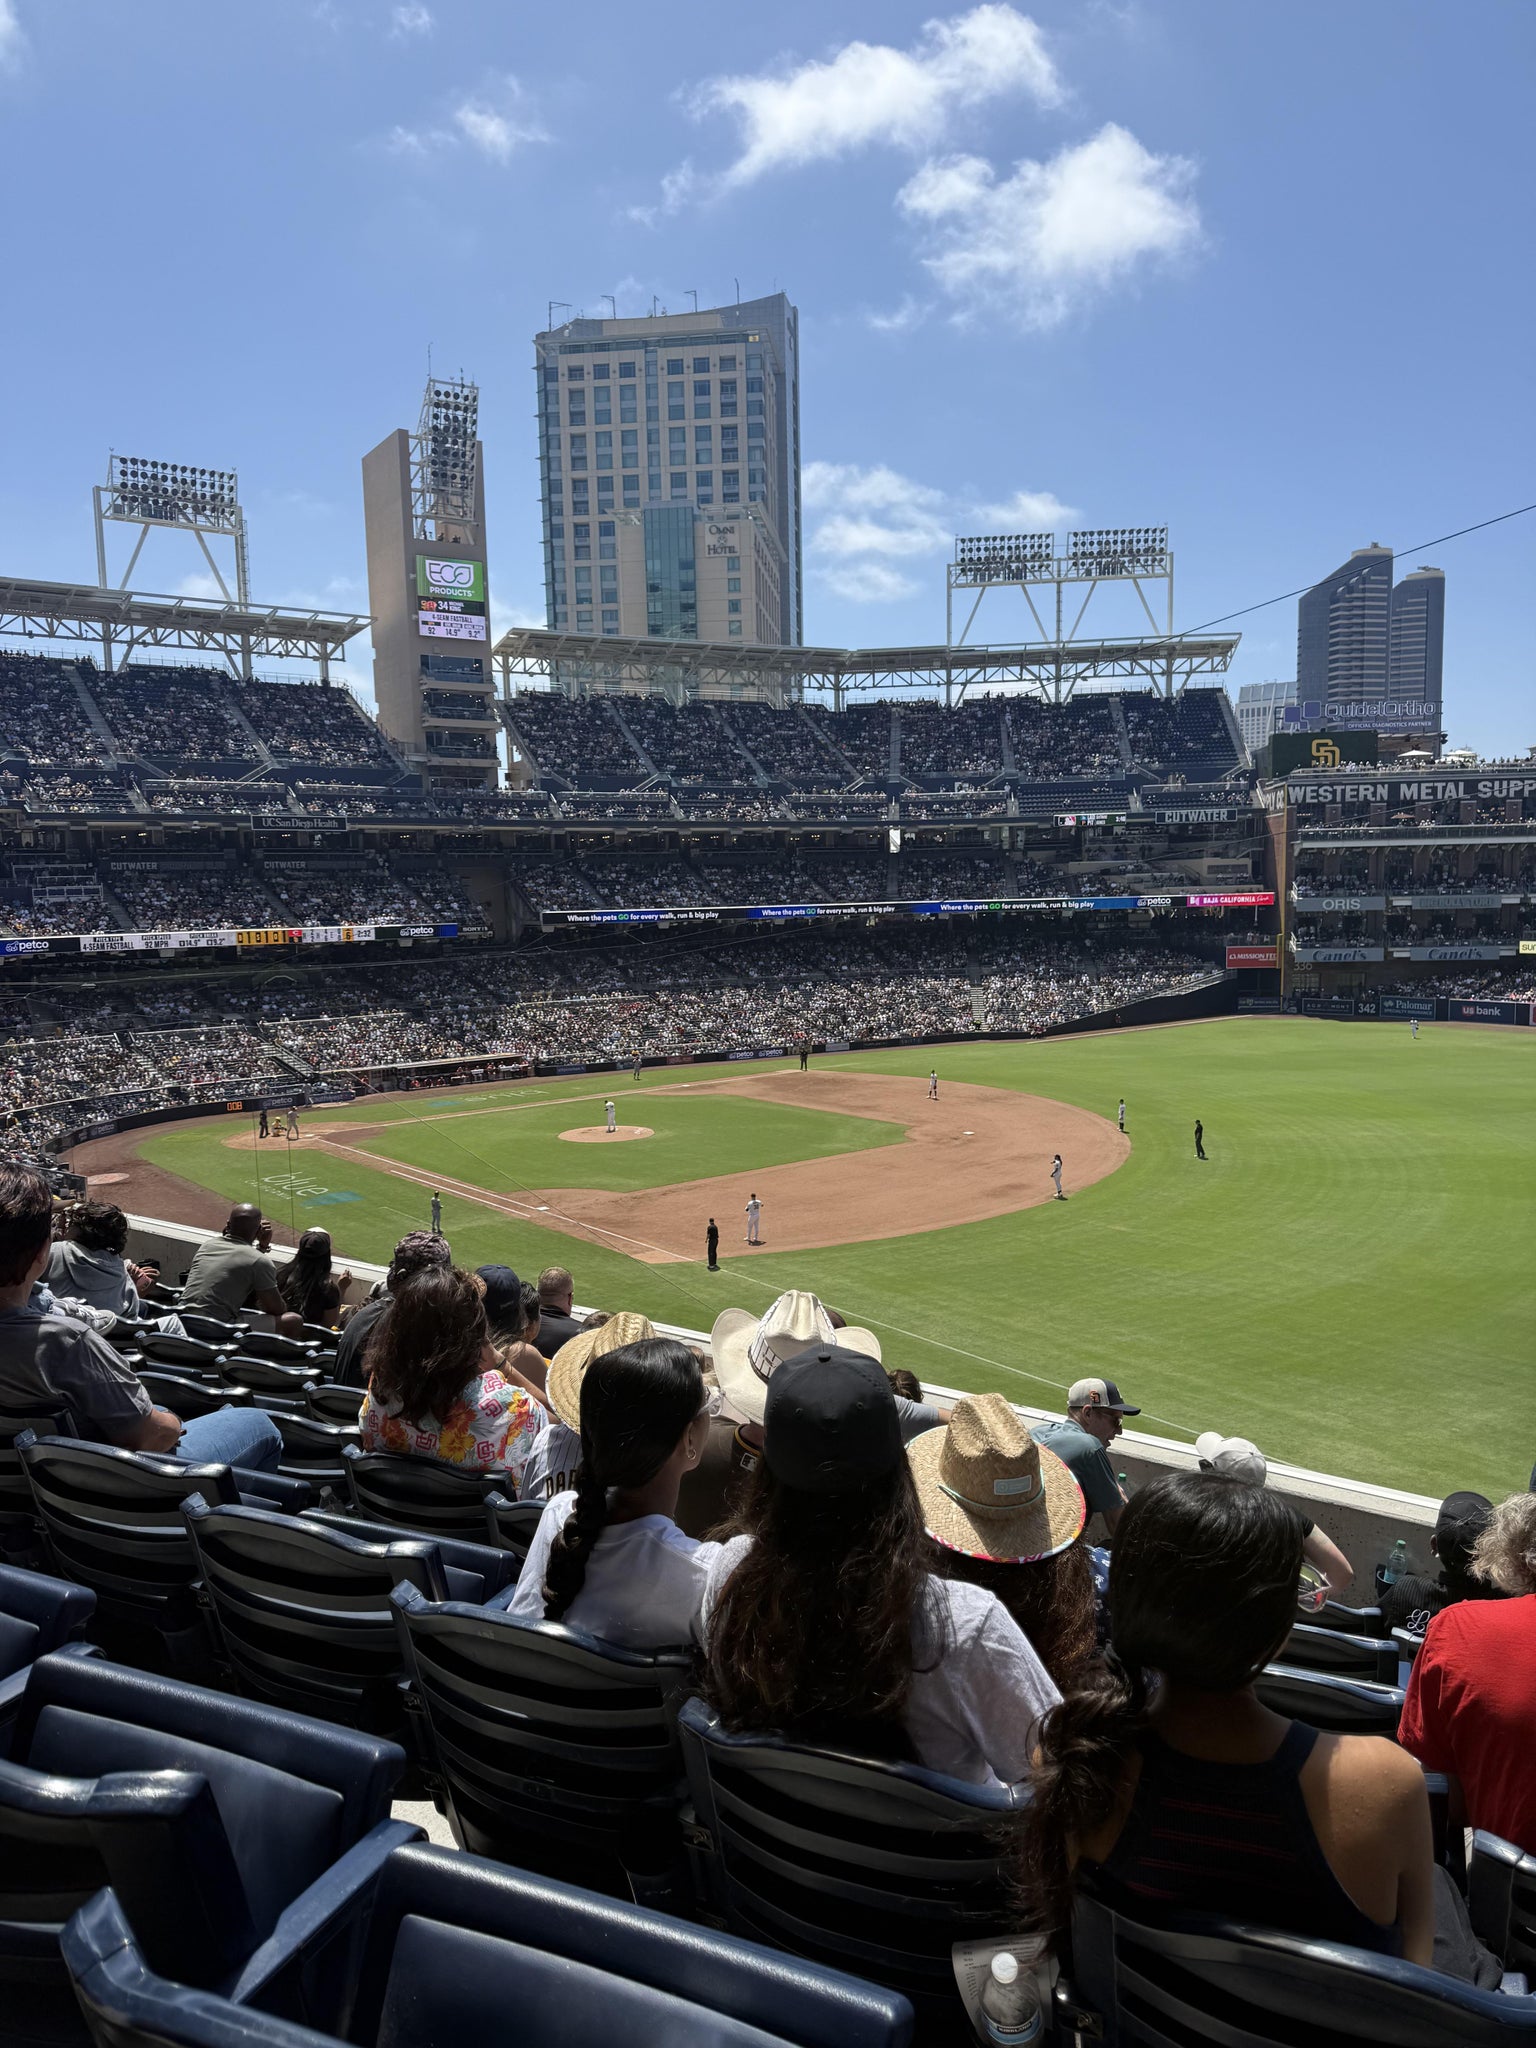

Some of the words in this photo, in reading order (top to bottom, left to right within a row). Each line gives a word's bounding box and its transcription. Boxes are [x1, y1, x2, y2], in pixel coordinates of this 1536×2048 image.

[707, 544, 738, 555] HOTEL
[429, 586, 473, 598] PRODUCTS
[437, 600, 449, 611] 34
[450, 615, 473, 624] FASTBALL
[1325, 700, 1436, 722] QuidelOrtho
[1372, 721, 1407, 729] DIAGNOSTICS
[1408, 720, 1432, 728] PARTNER
[1288, 783, 1388, 803] WESTERN
[1400, 781, 1471, 801] METAL
[1477, 780, 1536, 799] SUPP
[1164, 810, 1228, 823] CUTWATER
[291, 818, 313, 829] Diego
[313, 818, 338, 828] Health
[111, 861, 158, 870] CUTWATER
[263, 860, 306, 869] CUTWATER
[1147, 897, 1172, 906] petco
[1220, 896, 1256, 904] CALIFORNIA
[1322, 898, 1361, 910] ORIS
[762, 909, 781, 917] Where
[792, 909, 806, 917] pets
[816, 907, 825, 915] for
[873, 905, 882, 914] big
[883, 905, 895, 913] play
[940, 903, 962, 911] Where
[962, 903, 974, 911] the
[974, 904, 989, 912] pets
[1012, 902, 1030, 910] every
[1068, 900, 1079, 909] big
[1080, 901, 1094, 909] play
[567, 914, 590, 922] Where
[591, 914, 602, 922] the
[602, 914, 617, 923] pets
[618, 913, 629, 921] GO
[640, 913, 659, 921] every
[688, 911, 694, 919] &
[694, 911, 705, 920] big
[705, 911, 719, 920] play
[410, 926, 434, 935] petco
[345, 932, 351, 941] 6
[19, 940, 49, 952] petco
[83, 942, 105, 951] 4-SEAM
[106, 941, 135, 950] FASTBALL
[145, 941, 153, 949] 92
[154, 940, 169, 948] MPH
[1312, 949, 1367, 962] Canel's
[1428, 947, 1483, 960] Canel's
[1358, 1003, 1376, 1014] 342
[1396, 1000, 1433, 1011] Palomar
[1462, 1006, 1475, 1014] us
[1476, 1006, 1501, 1016] bank
[736, 1050, 754, 1059] petco
[766, 1048, 783, 1057] petco
[271, 1096, 293, 1106] petco
